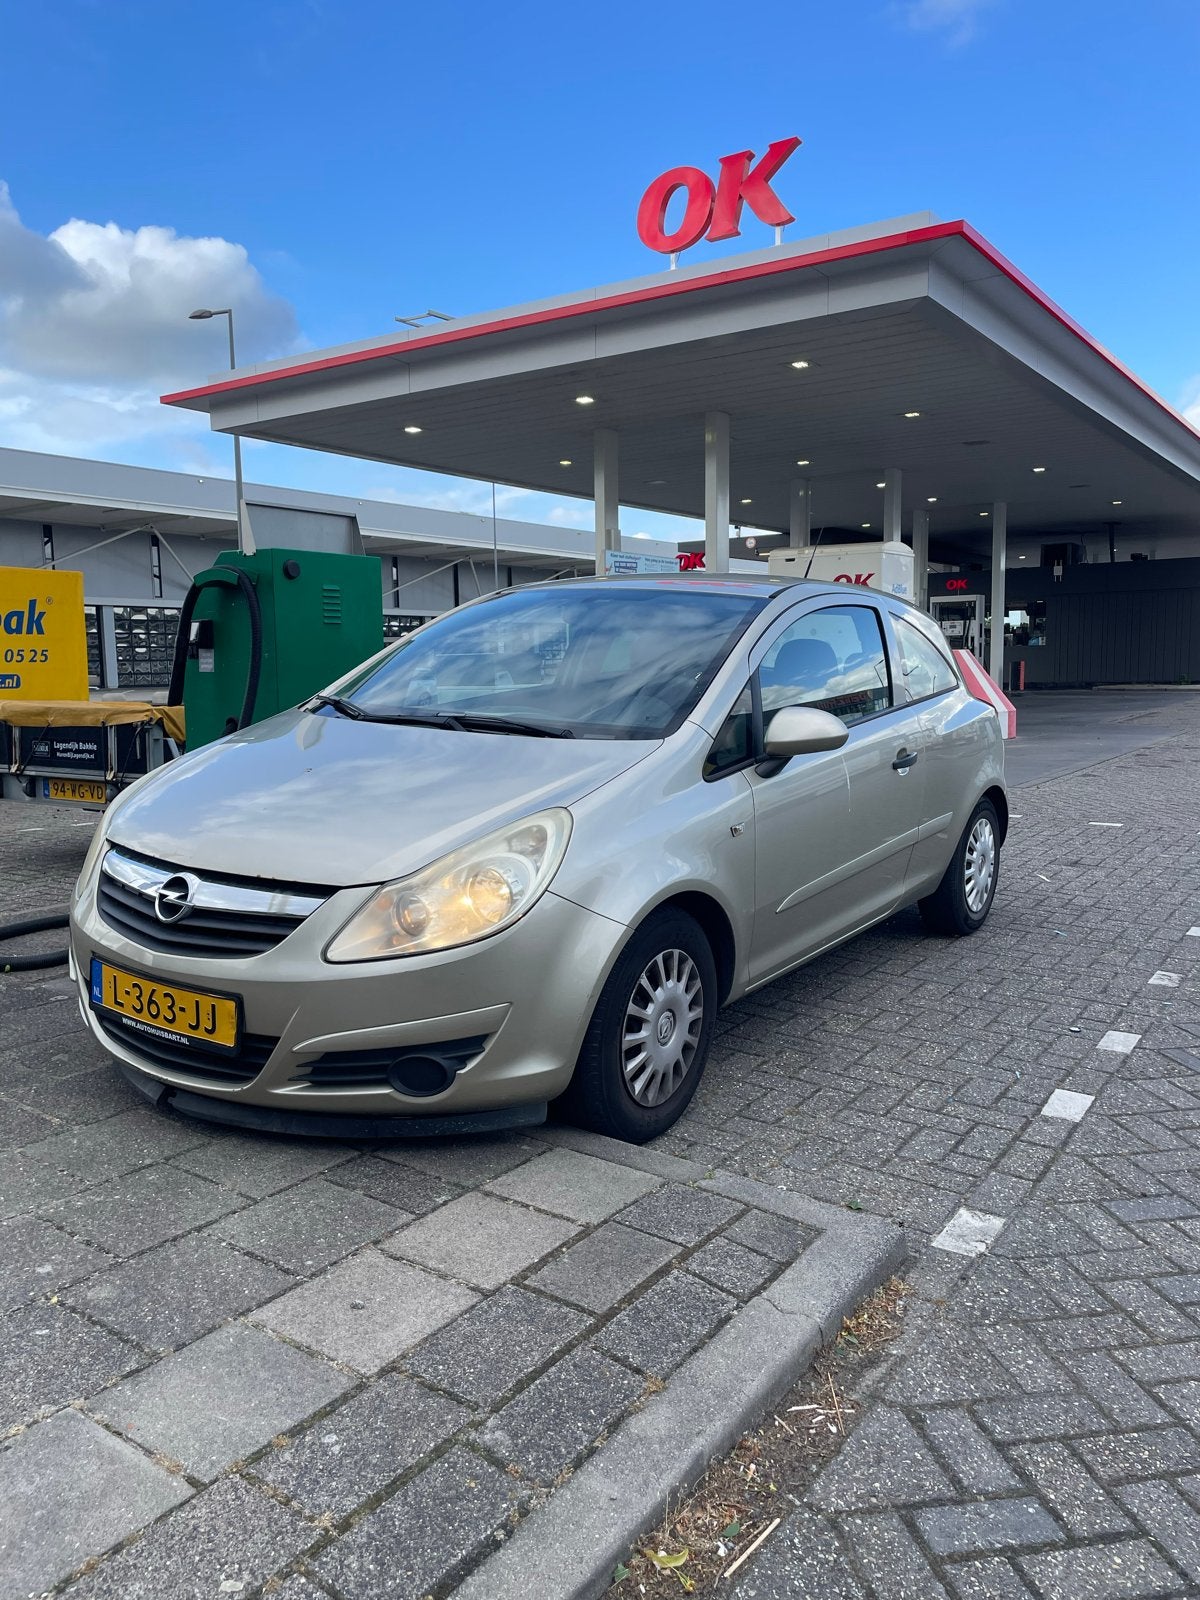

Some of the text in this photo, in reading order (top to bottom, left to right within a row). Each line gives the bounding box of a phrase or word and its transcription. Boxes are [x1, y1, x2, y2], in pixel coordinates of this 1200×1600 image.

[637, 136, 802, 254] OK
[676, 552, 705, 571] OK
[946, 578, 968, 590] OK
[0, 599, 46, 635] ak
[53, 741, 79, 751] Lagendijk
[79, 742, 97, 751] Bakkie
[52, 782, 103, 800] 94-WG-VD
[93, 974, 217, 1035] NL L-363-JJ
[121, 1017, 190, 1045] WWW.AUTOHUISBART.NL
